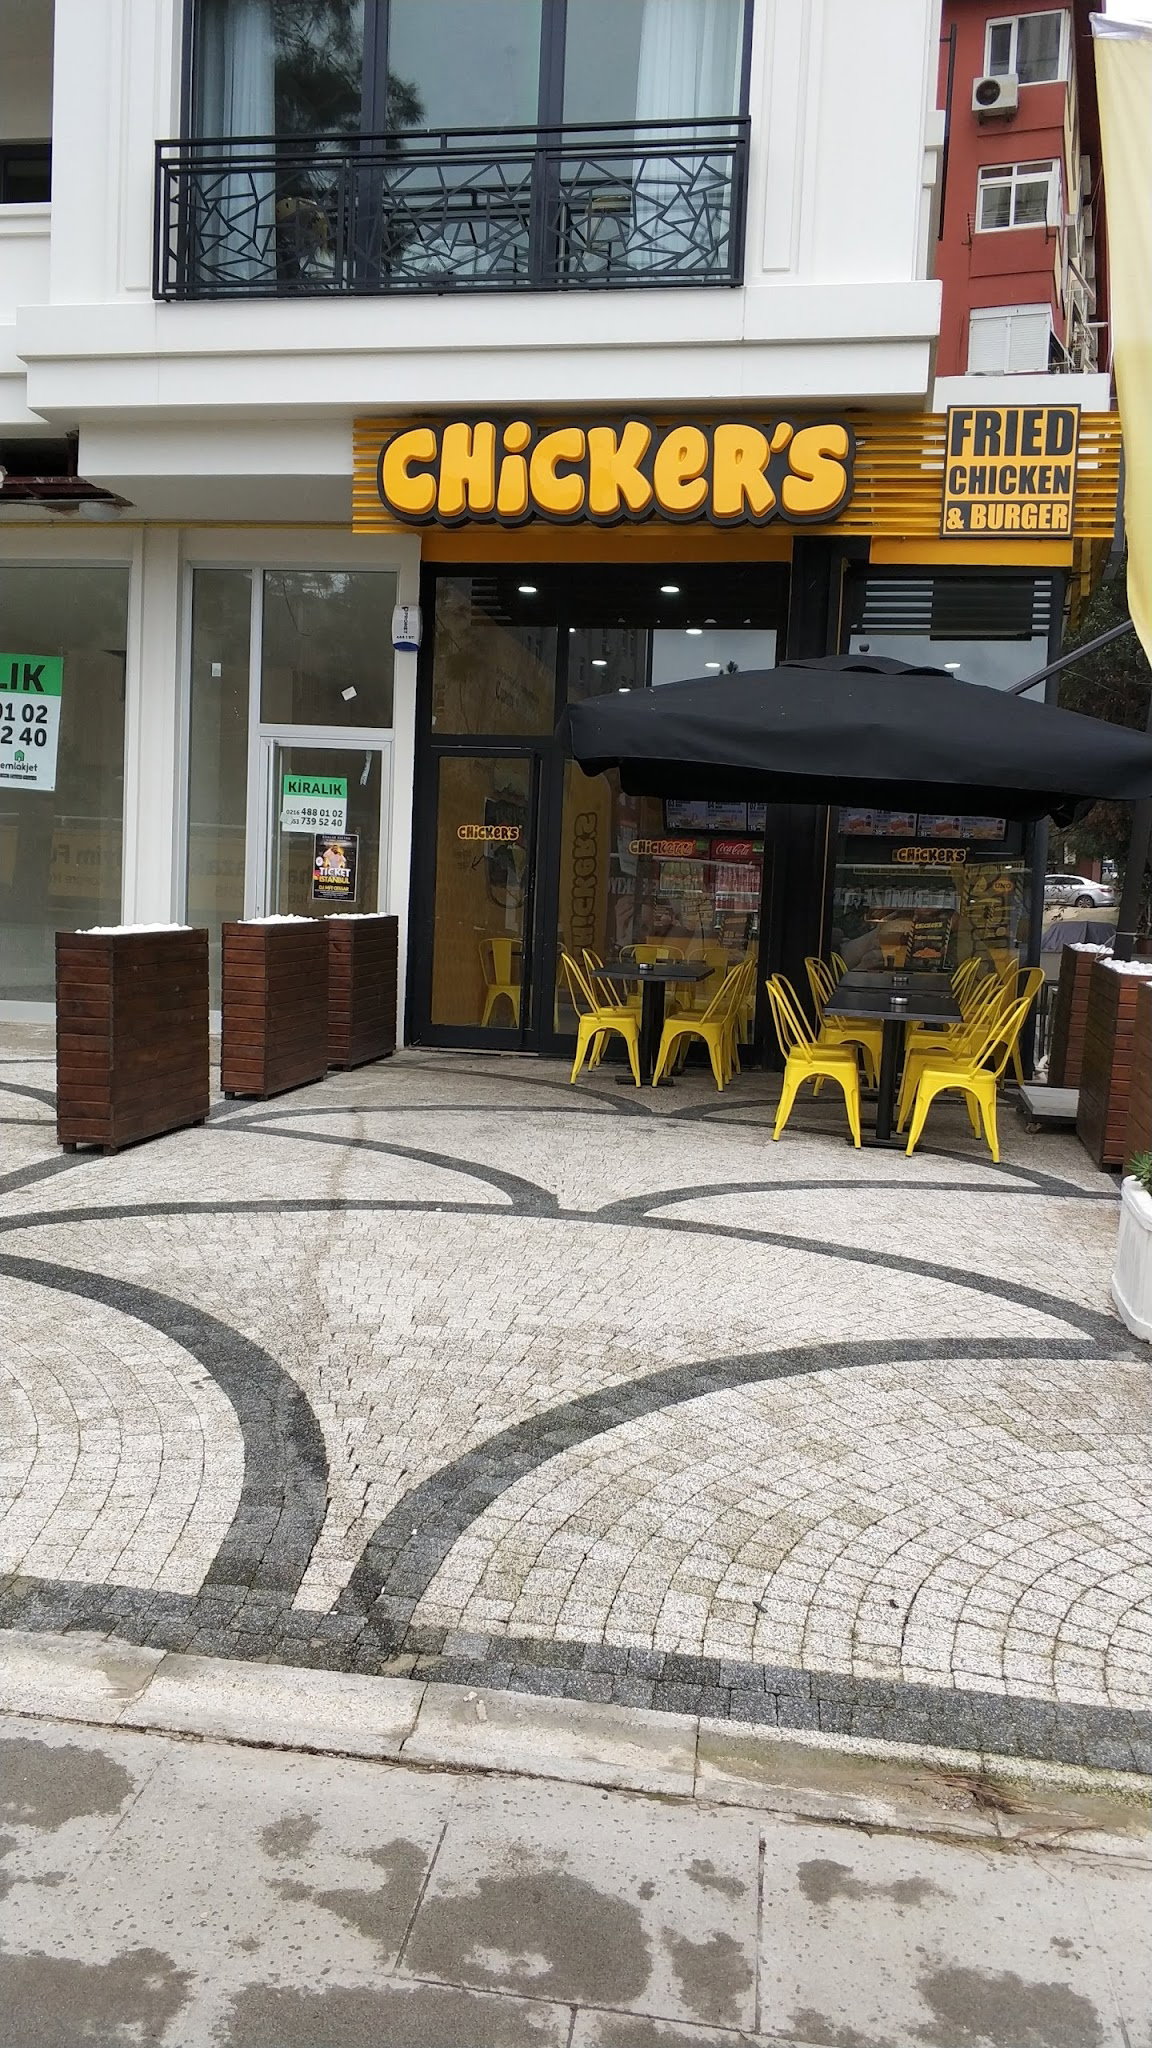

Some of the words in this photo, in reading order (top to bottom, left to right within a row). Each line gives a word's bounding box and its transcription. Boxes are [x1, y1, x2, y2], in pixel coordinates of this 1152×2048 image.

[951, 409, 1075, 456] FRIED
[948, 465, 1071, 495] CHICKEN
[946, 507, 964, 529] &
[970, 503, 1068, 529] BURGER
[0, 703, 15, 721] 1
[22, 704, 48, 724] 02
[19, 727, 47, 747] 40
[288, 779, 343, 795] KİRALIK
[301, 807, 318, 817] 488
[319, 809, 330, 817] 01
[332, 809, 343, 818] 02
[301, 817, 316, 826] 739
[319, 818, 329, 826] 52
[331, 818, 343, 827] 40
[319, 867, 351, 877] TICKET
